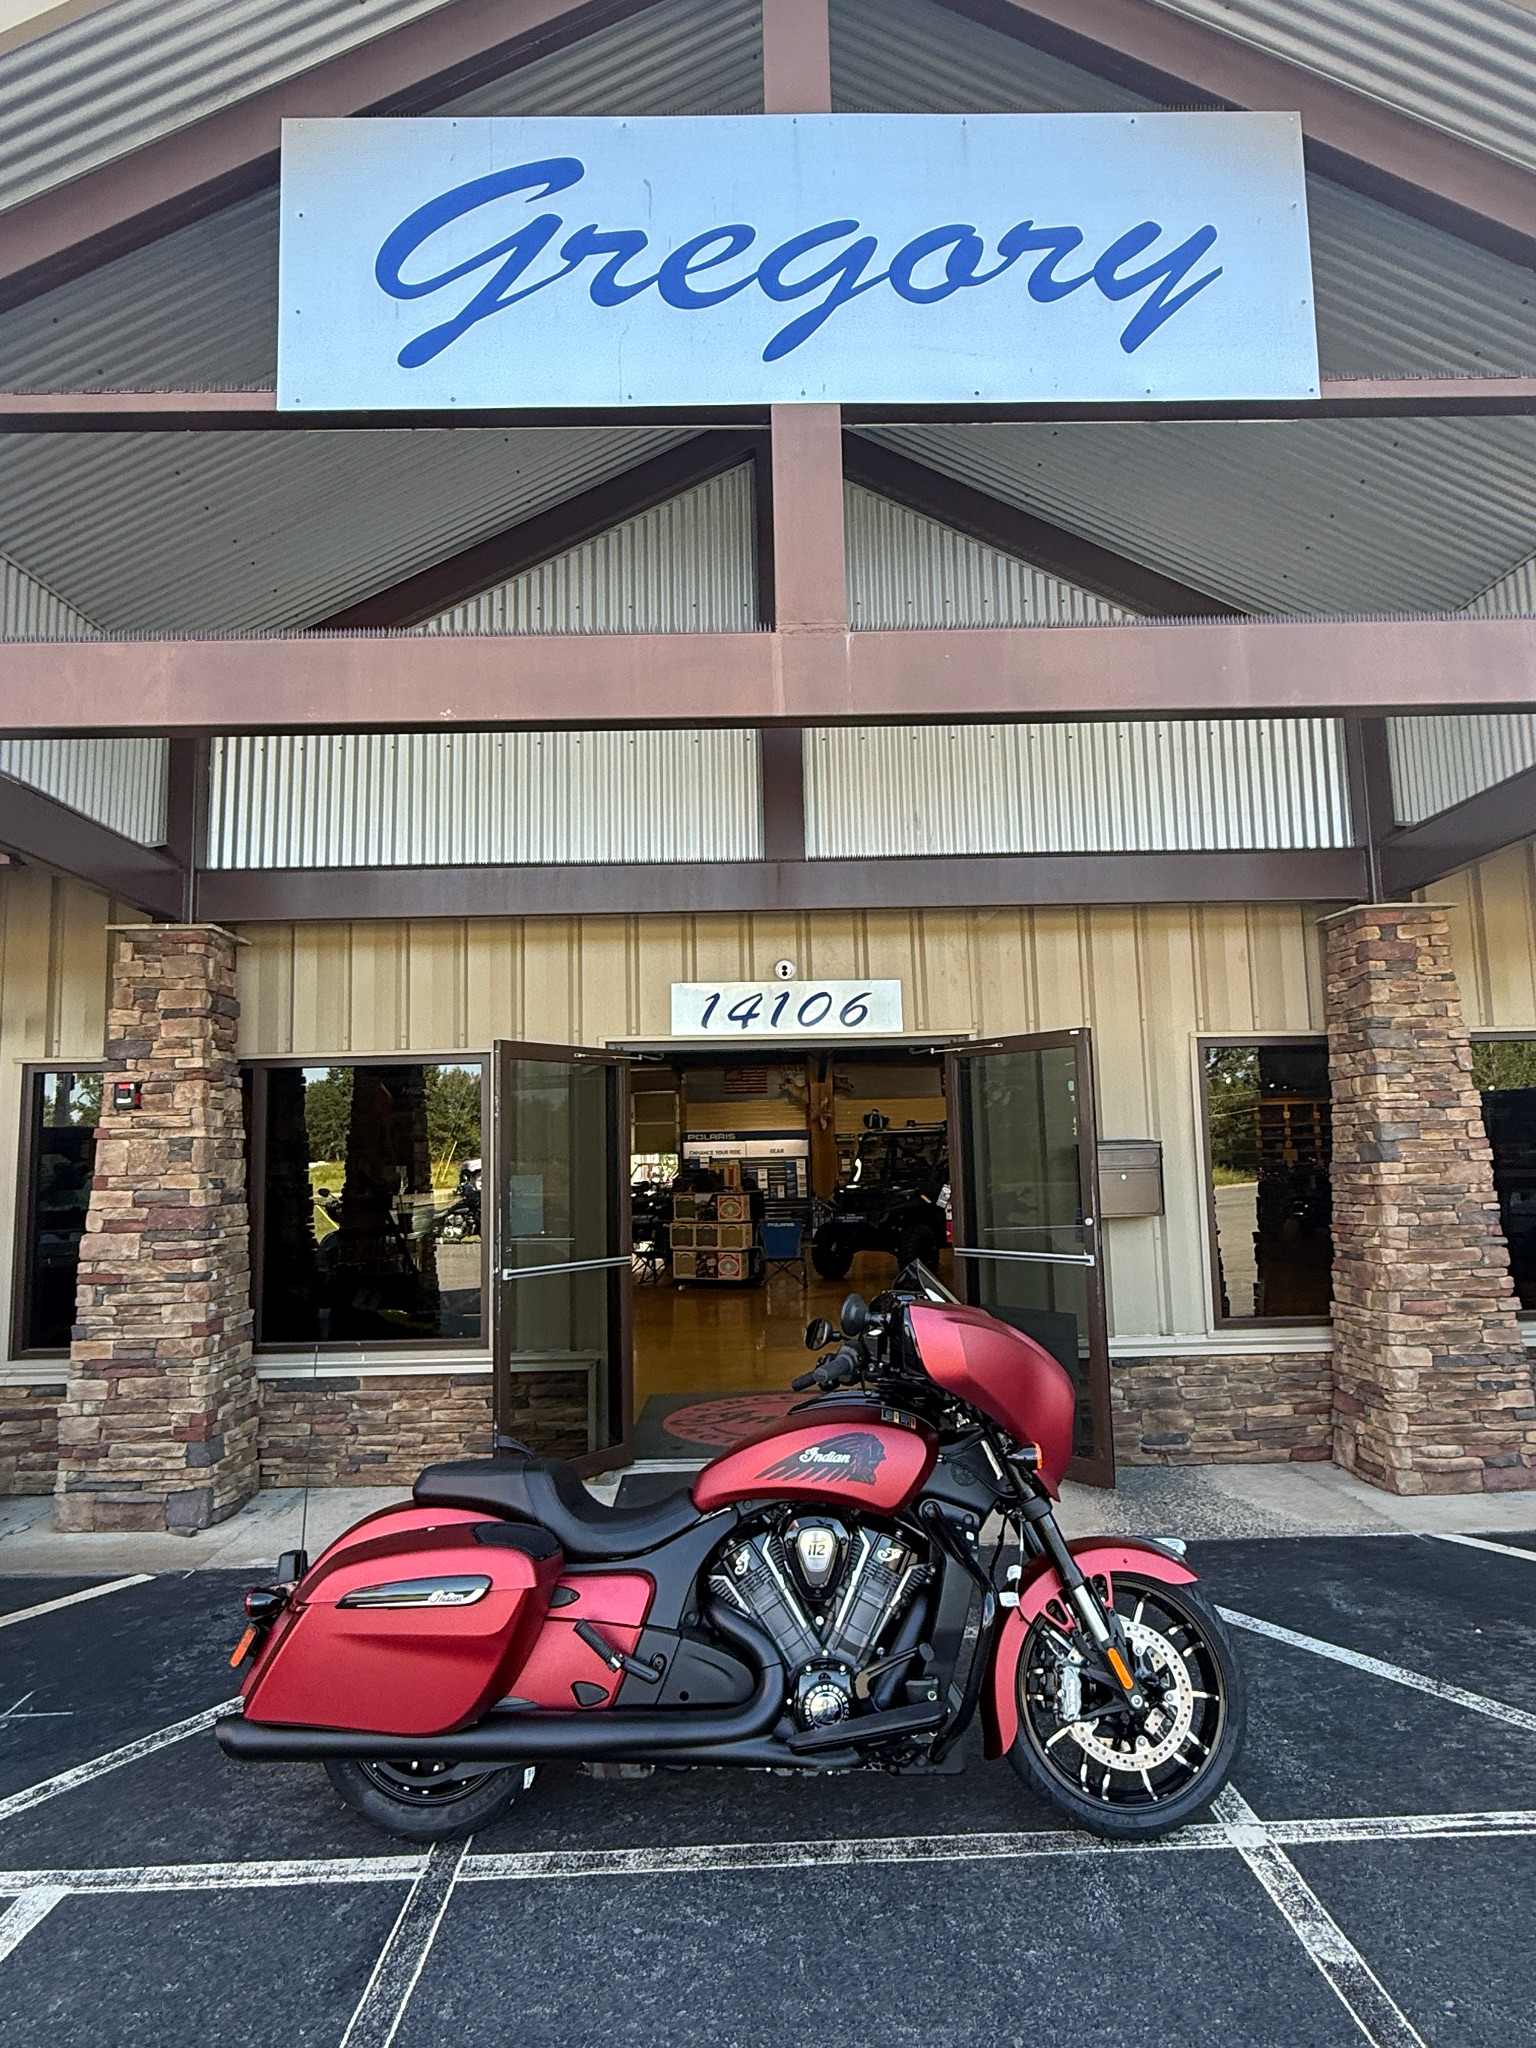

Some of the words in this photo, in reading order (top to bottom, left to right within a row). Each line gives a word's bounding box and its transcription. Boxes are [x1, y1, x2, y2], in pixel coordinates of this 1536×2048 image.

[375, 157, 1223, 368] Gregory
[701, 991, 872, 1029] 14106
[687, 1133, 736, 1141] POLARIS
[799, 1447, 851, 1463] Indian
[808, 1544, 825, 1556] 112
[428, 1590, 464, 1603] Indian
